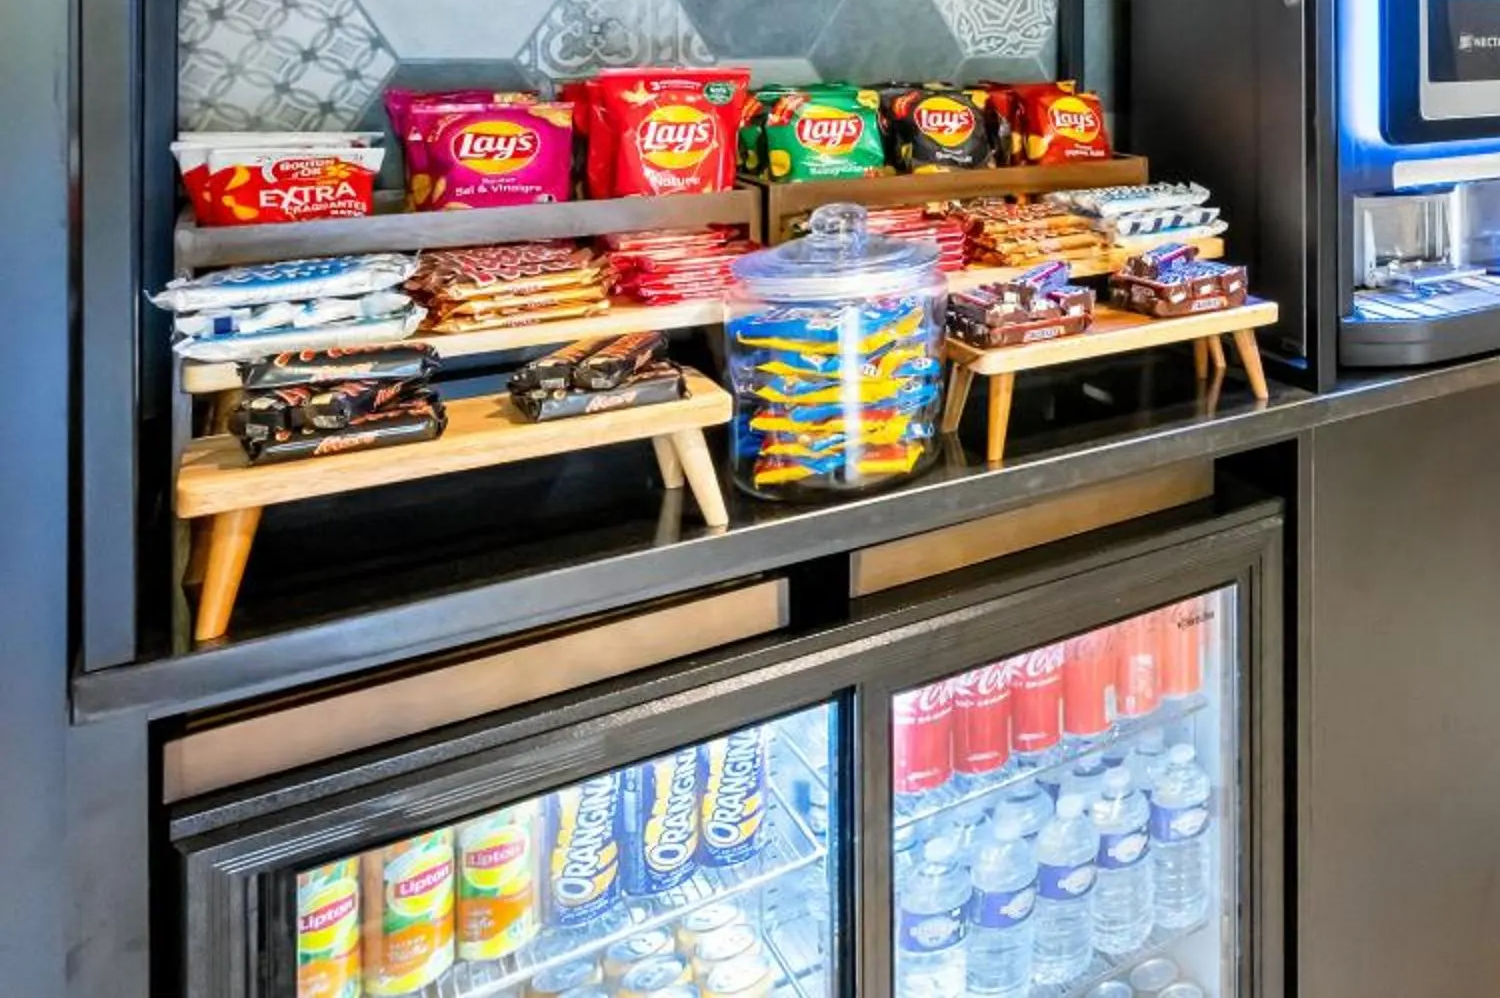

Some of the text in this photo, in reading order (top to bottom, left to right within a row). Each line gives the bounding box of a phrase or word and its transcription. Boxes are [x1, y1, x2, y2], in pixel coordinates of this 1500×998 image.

[458, 132, 535, 162] Lay's
[643, 120, 711, 154] Lay's
[259, 181, 357, 210] EXTRA
[645, 748, 697, 874] ORANGIN
[400, 864, 450, 897] Lipton
[299, 898, 354, 932] Lipton
